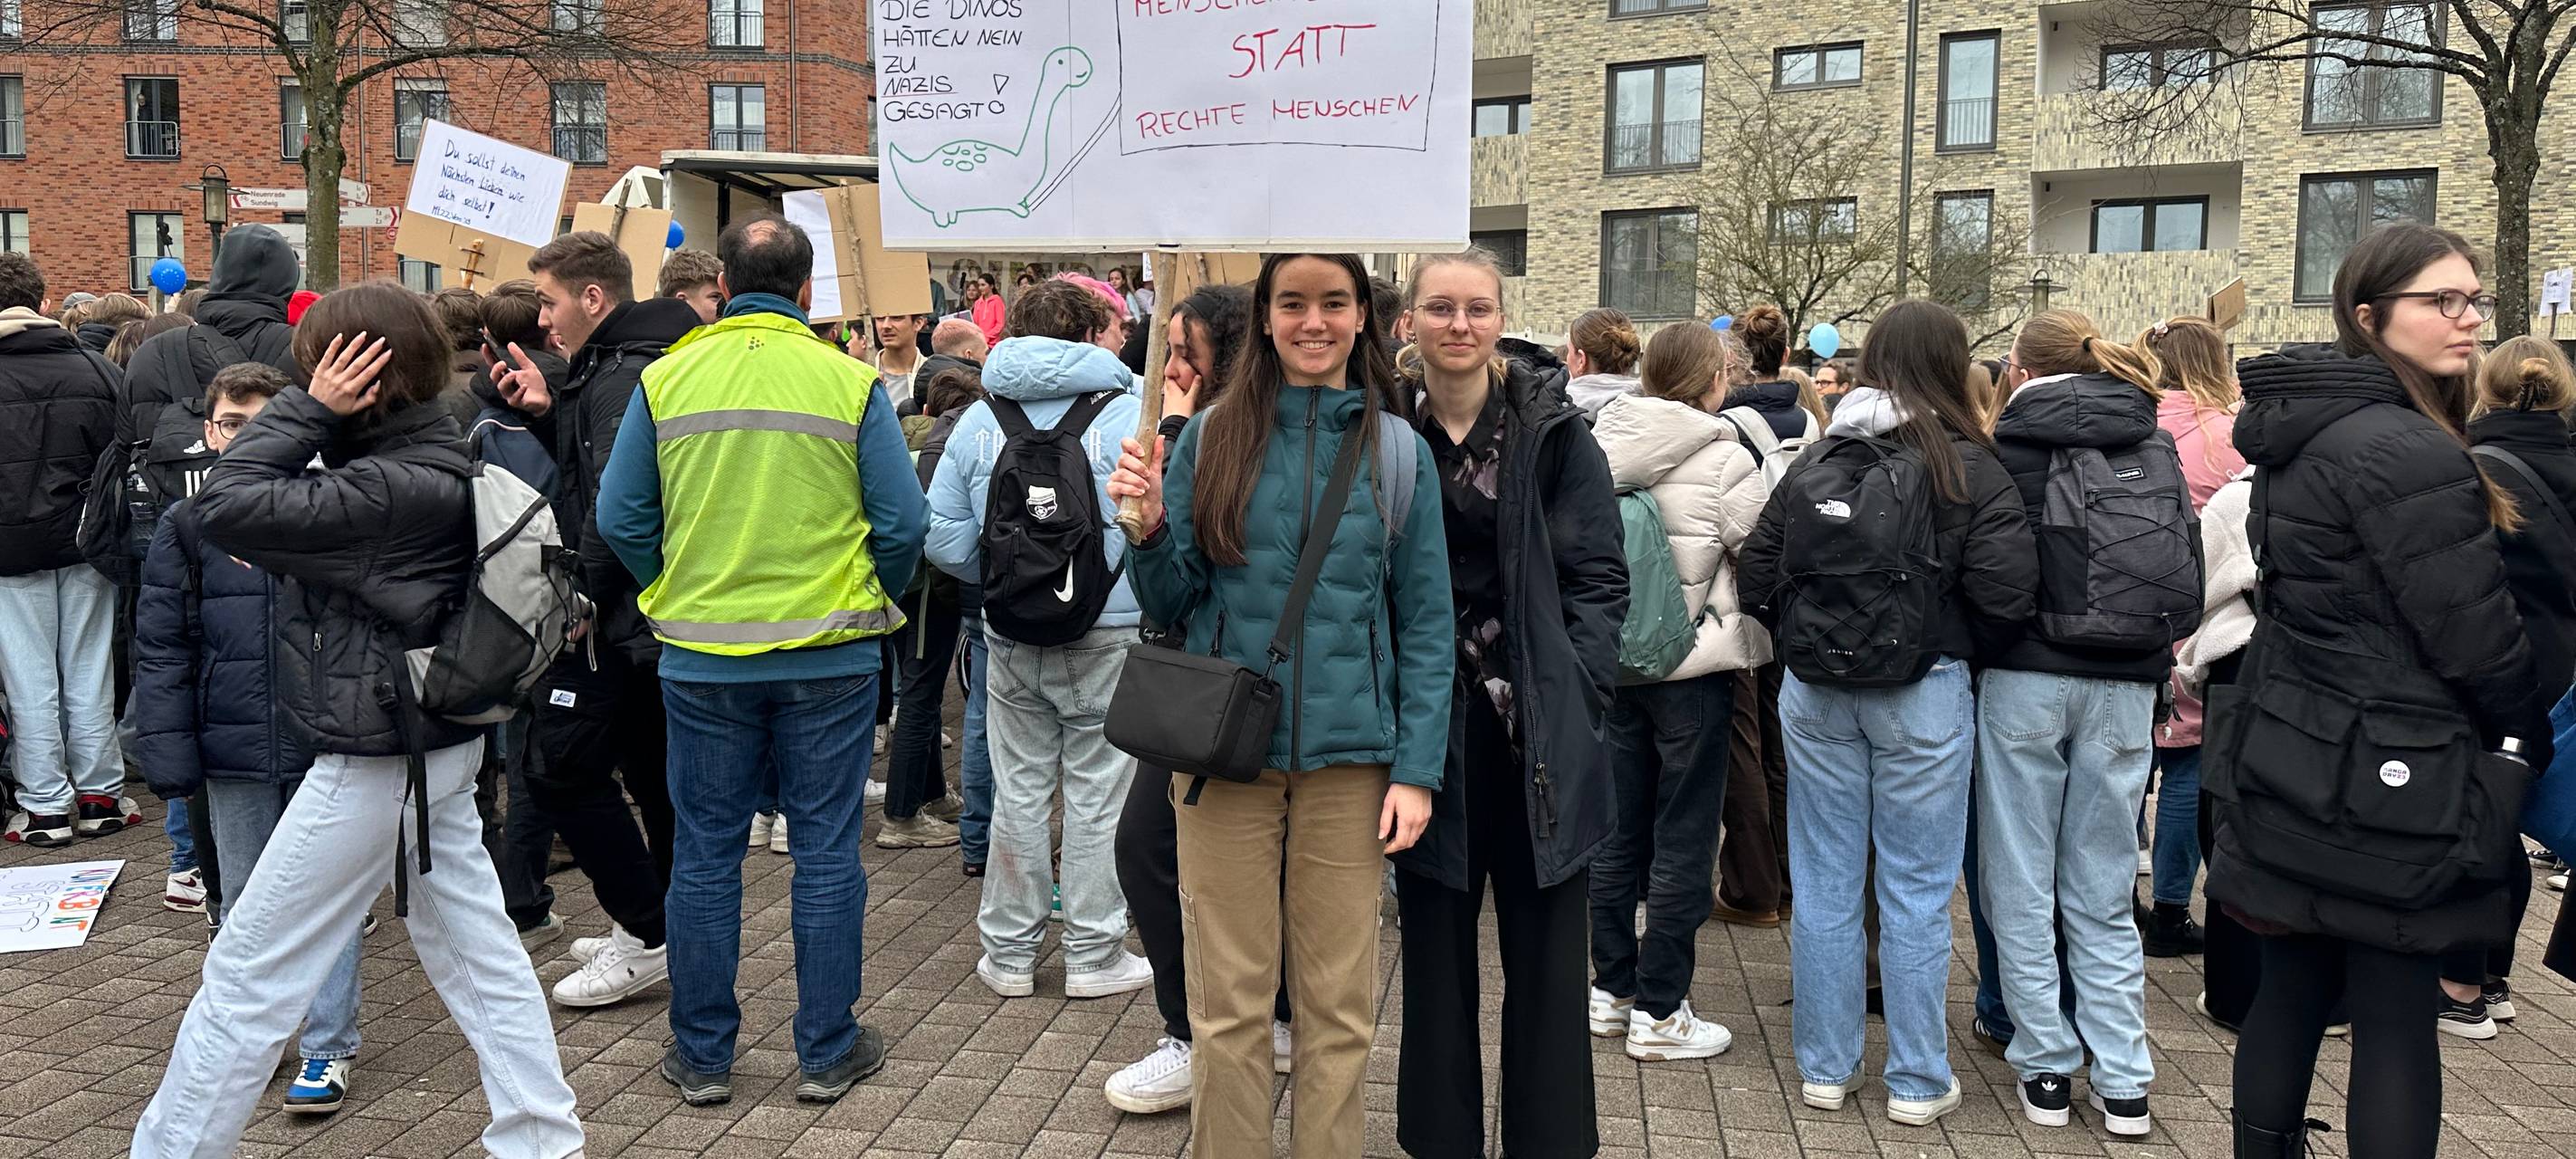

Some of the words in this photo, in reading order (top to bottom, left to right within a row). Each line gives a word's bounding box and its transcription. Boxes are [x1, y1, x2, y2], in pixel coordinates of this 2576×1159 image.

[880, 0, 930, 20] DIE
[945, 0, 1023, 19] DINOS
[978, 29, 1023, 46] NEIN
[1229, 24, 1377, 78] STATT
[883, 55, 916, 73] ZU
[883, 75, 953, 96] NAZIS
[1135, 102, 1246, 139] RECHTE
[1272, 93, 1419, 120] MENSCHEN
[444, 139, 460, 160] Du
[464, 152, 495, 171] sollst
[501, 162, 525, 181] deinen
[250, 190, 286, 198] Neuenrade
[441, 163, 474, 187] Nächsten
[509, 191, 525, 204] wie
[250, 199, 279, 207] Sundwig
[437, 184, 455, 202] dich
[463, 196, 495, 219] selbst!
